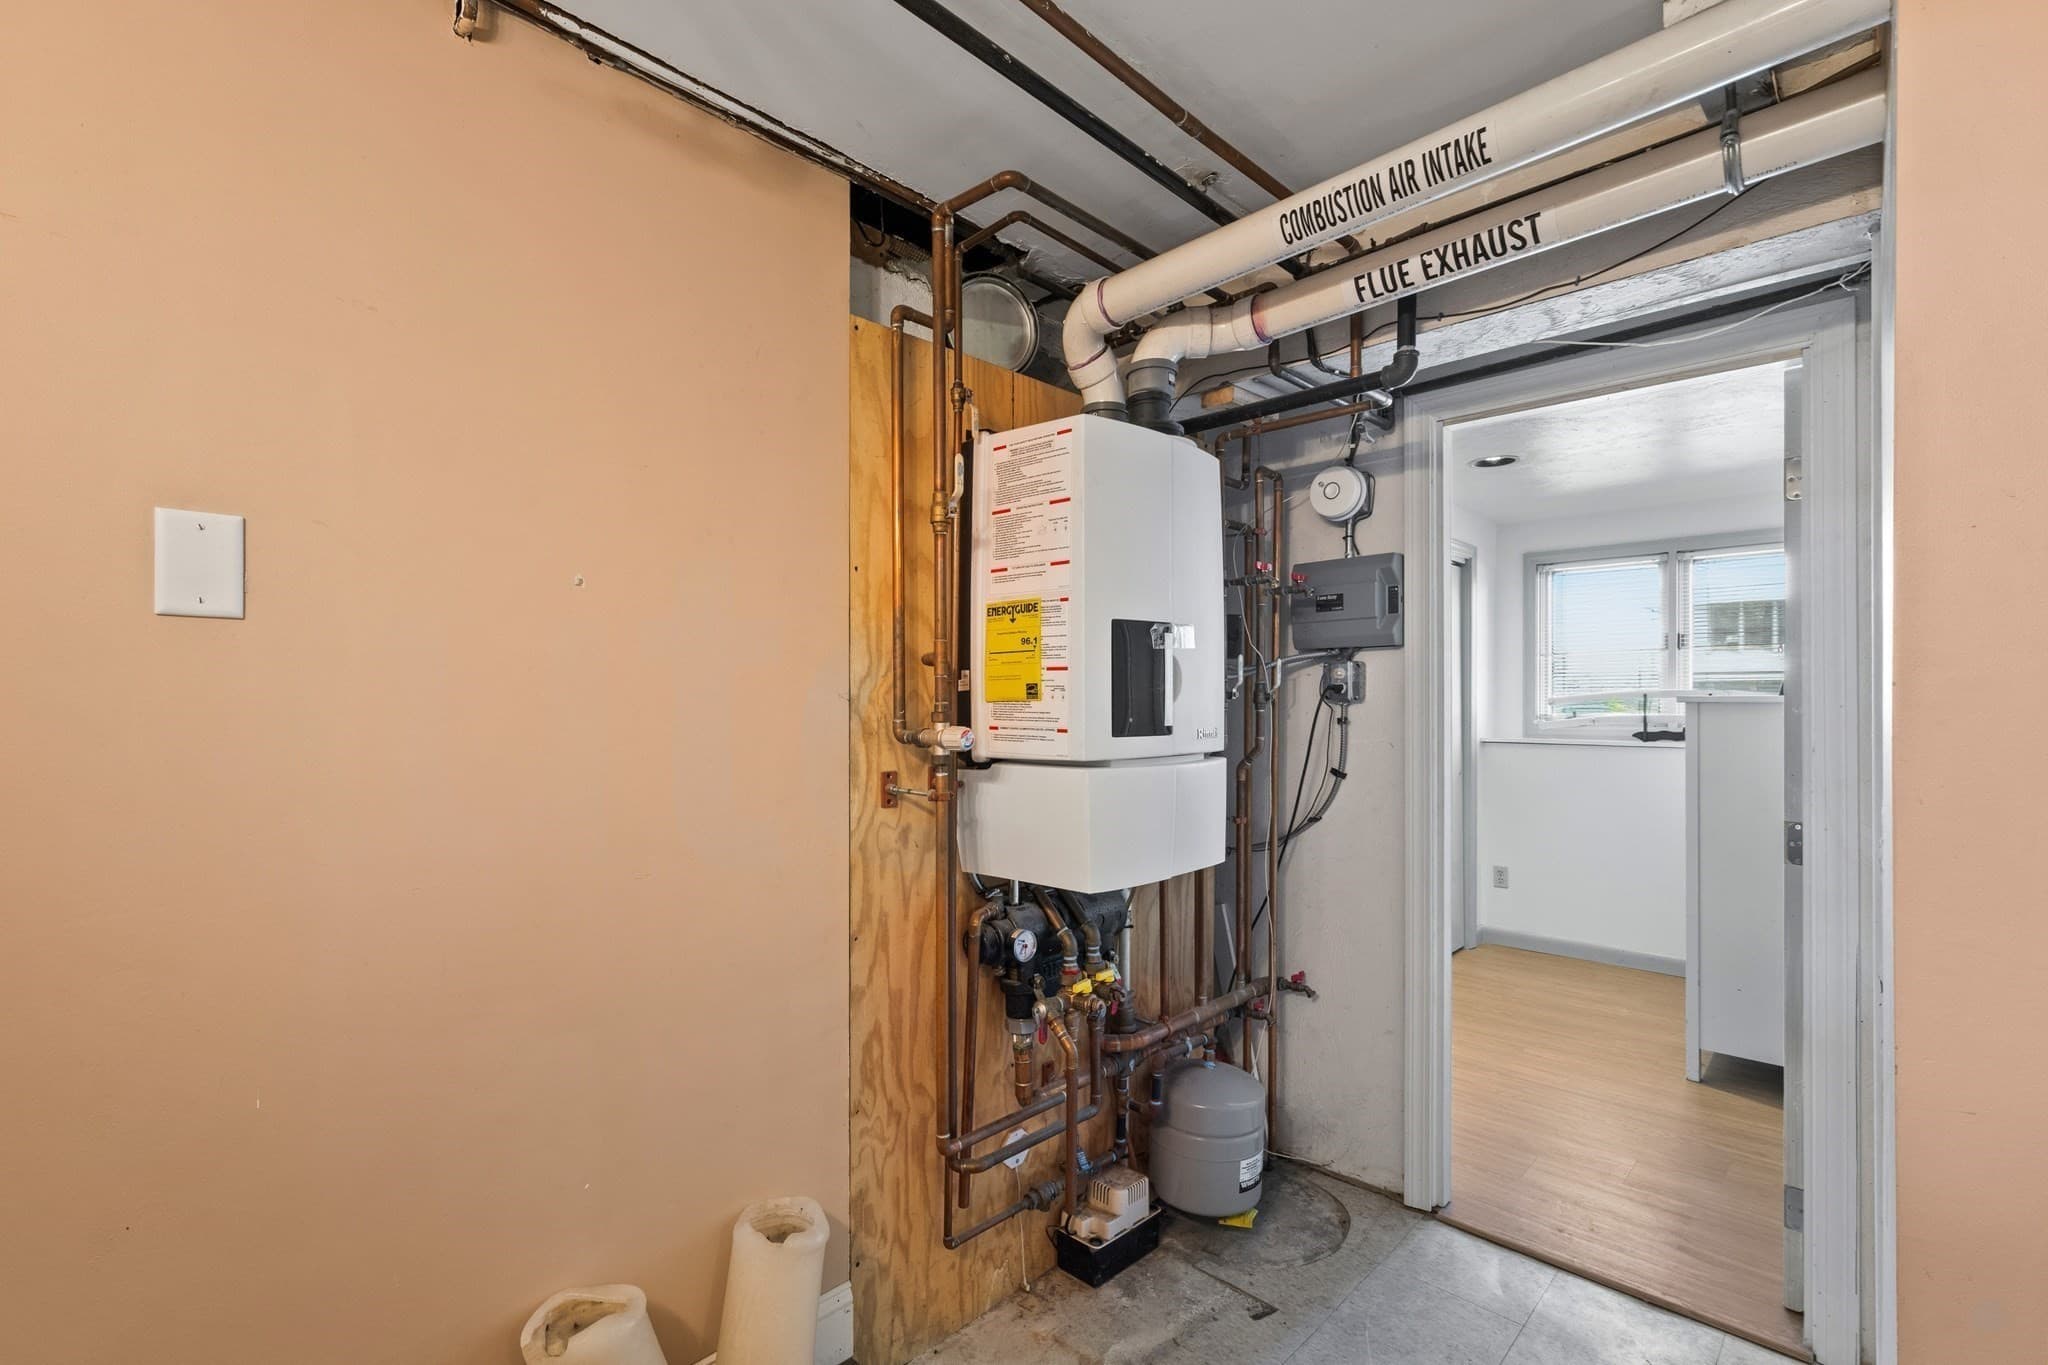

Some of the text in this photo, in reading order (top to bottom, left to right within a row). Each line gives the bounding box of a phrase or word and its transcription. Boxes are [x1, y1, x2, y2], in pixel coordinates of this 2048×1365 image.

[1279, 126, 1492, 245] COMBUSTION AIR INTAKE
[1353, 212, 1541, 302] FLUE EXHAUST
[986, 602, 1039, 618] ENERGYGUIDE
[1020, 637, 1038, 646] 96.1
